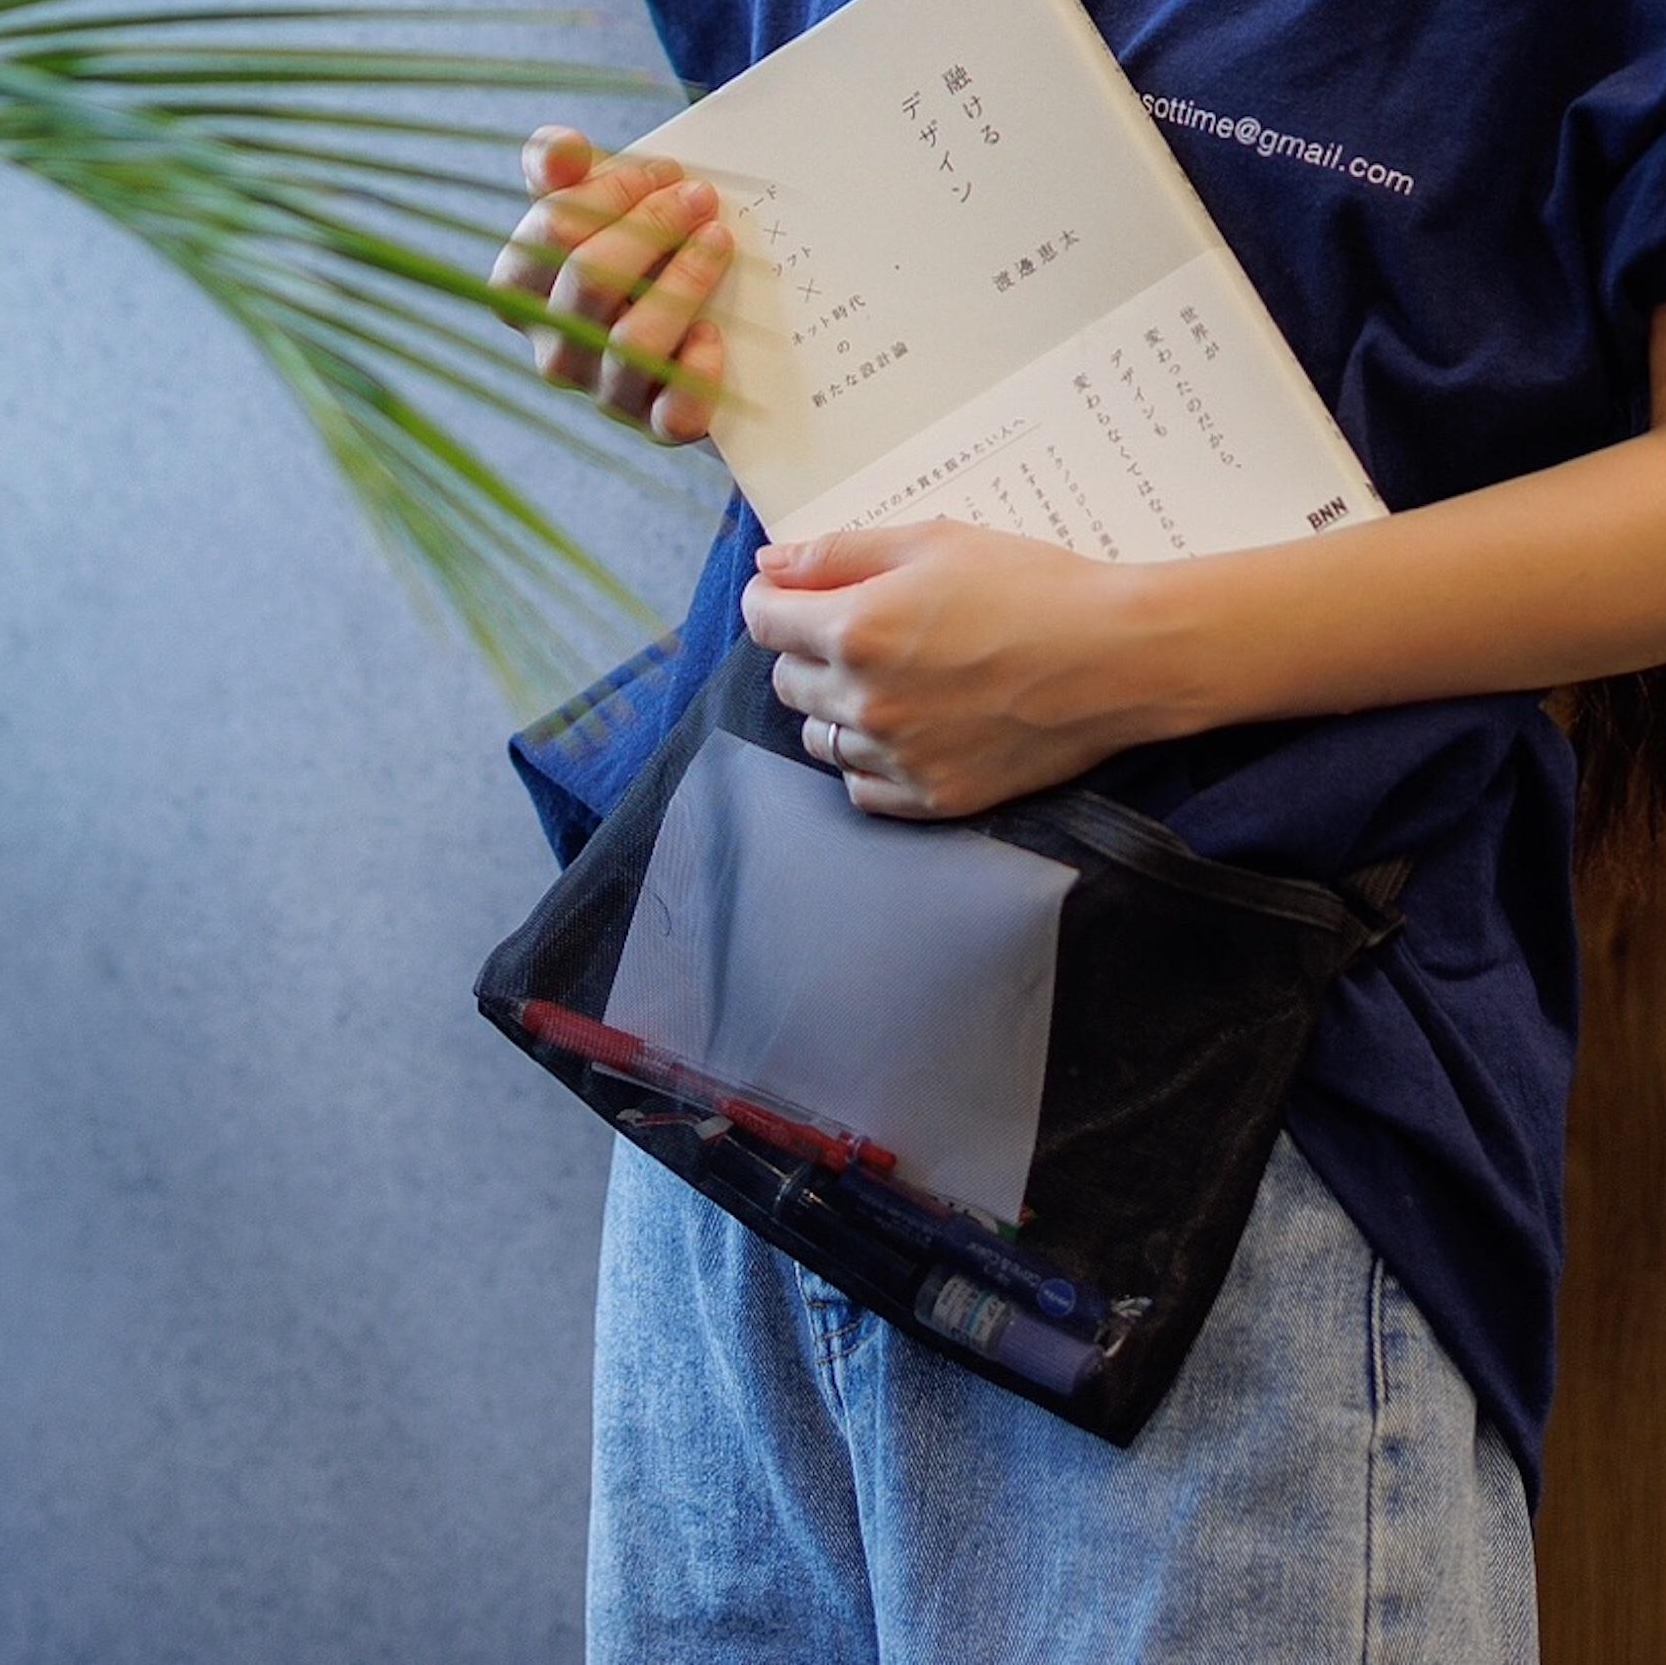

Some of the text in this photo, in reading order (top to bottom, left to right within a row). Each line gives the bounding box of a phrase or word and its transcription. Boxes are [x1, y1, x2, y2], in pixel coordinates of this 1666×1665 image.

[940, 64, 1000, 145] 融ける
[901, 91, 972, 203] デザイン
[1141, 92, 1415, 196] sottime@gmail.com
[772, 245, 812, 276] ソフト
[792, 294, 866, 346] ネット時代
[836, 339, 851, 354] の
[1180, 305, 1220, 361] 世界が
[812, 341, 908, 408] 新たな設計論
[1110, 348, 1168, 436] デザインも
[1073, 372, 1197, 558] 変わらなくてはならな
[1306, 496, 1348, 531] BNN
